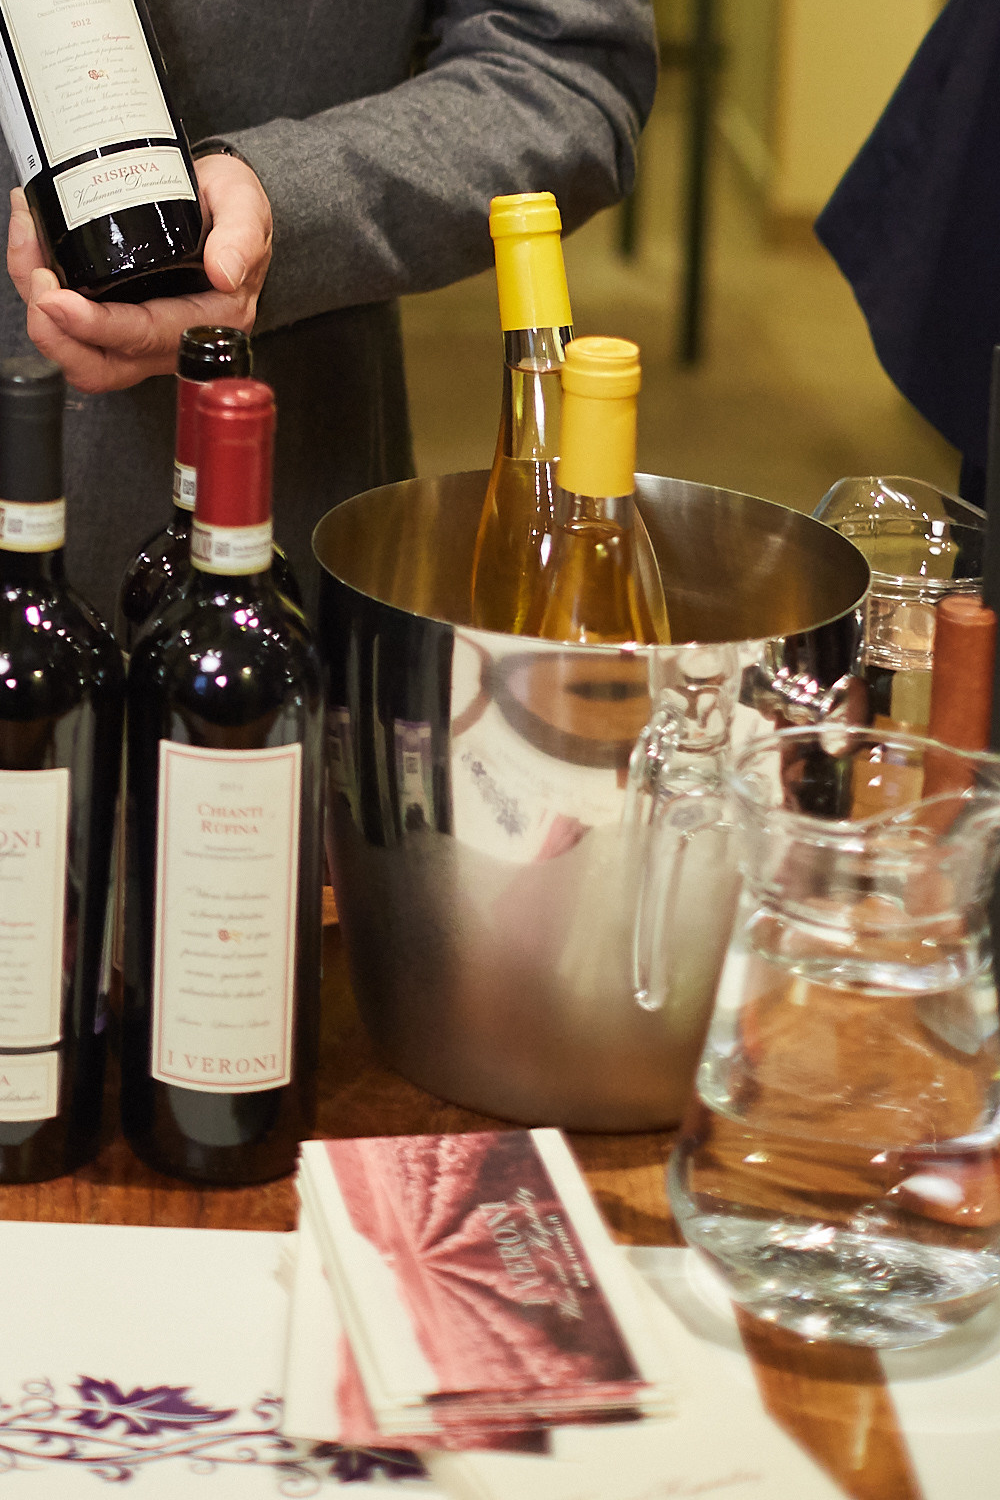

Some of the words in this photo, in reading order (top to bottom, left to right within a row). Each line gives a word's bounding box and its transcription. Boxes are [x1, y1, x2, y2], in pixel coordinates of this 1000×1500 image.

[71, 18, 92, 29] 2012
[92, 162, 160, 187] RISERVA
[167, 1050, 175, 1067] I
[183, 1053, 278, 1076] VERONI
[479, 1200, 545, 1291] VERONI
